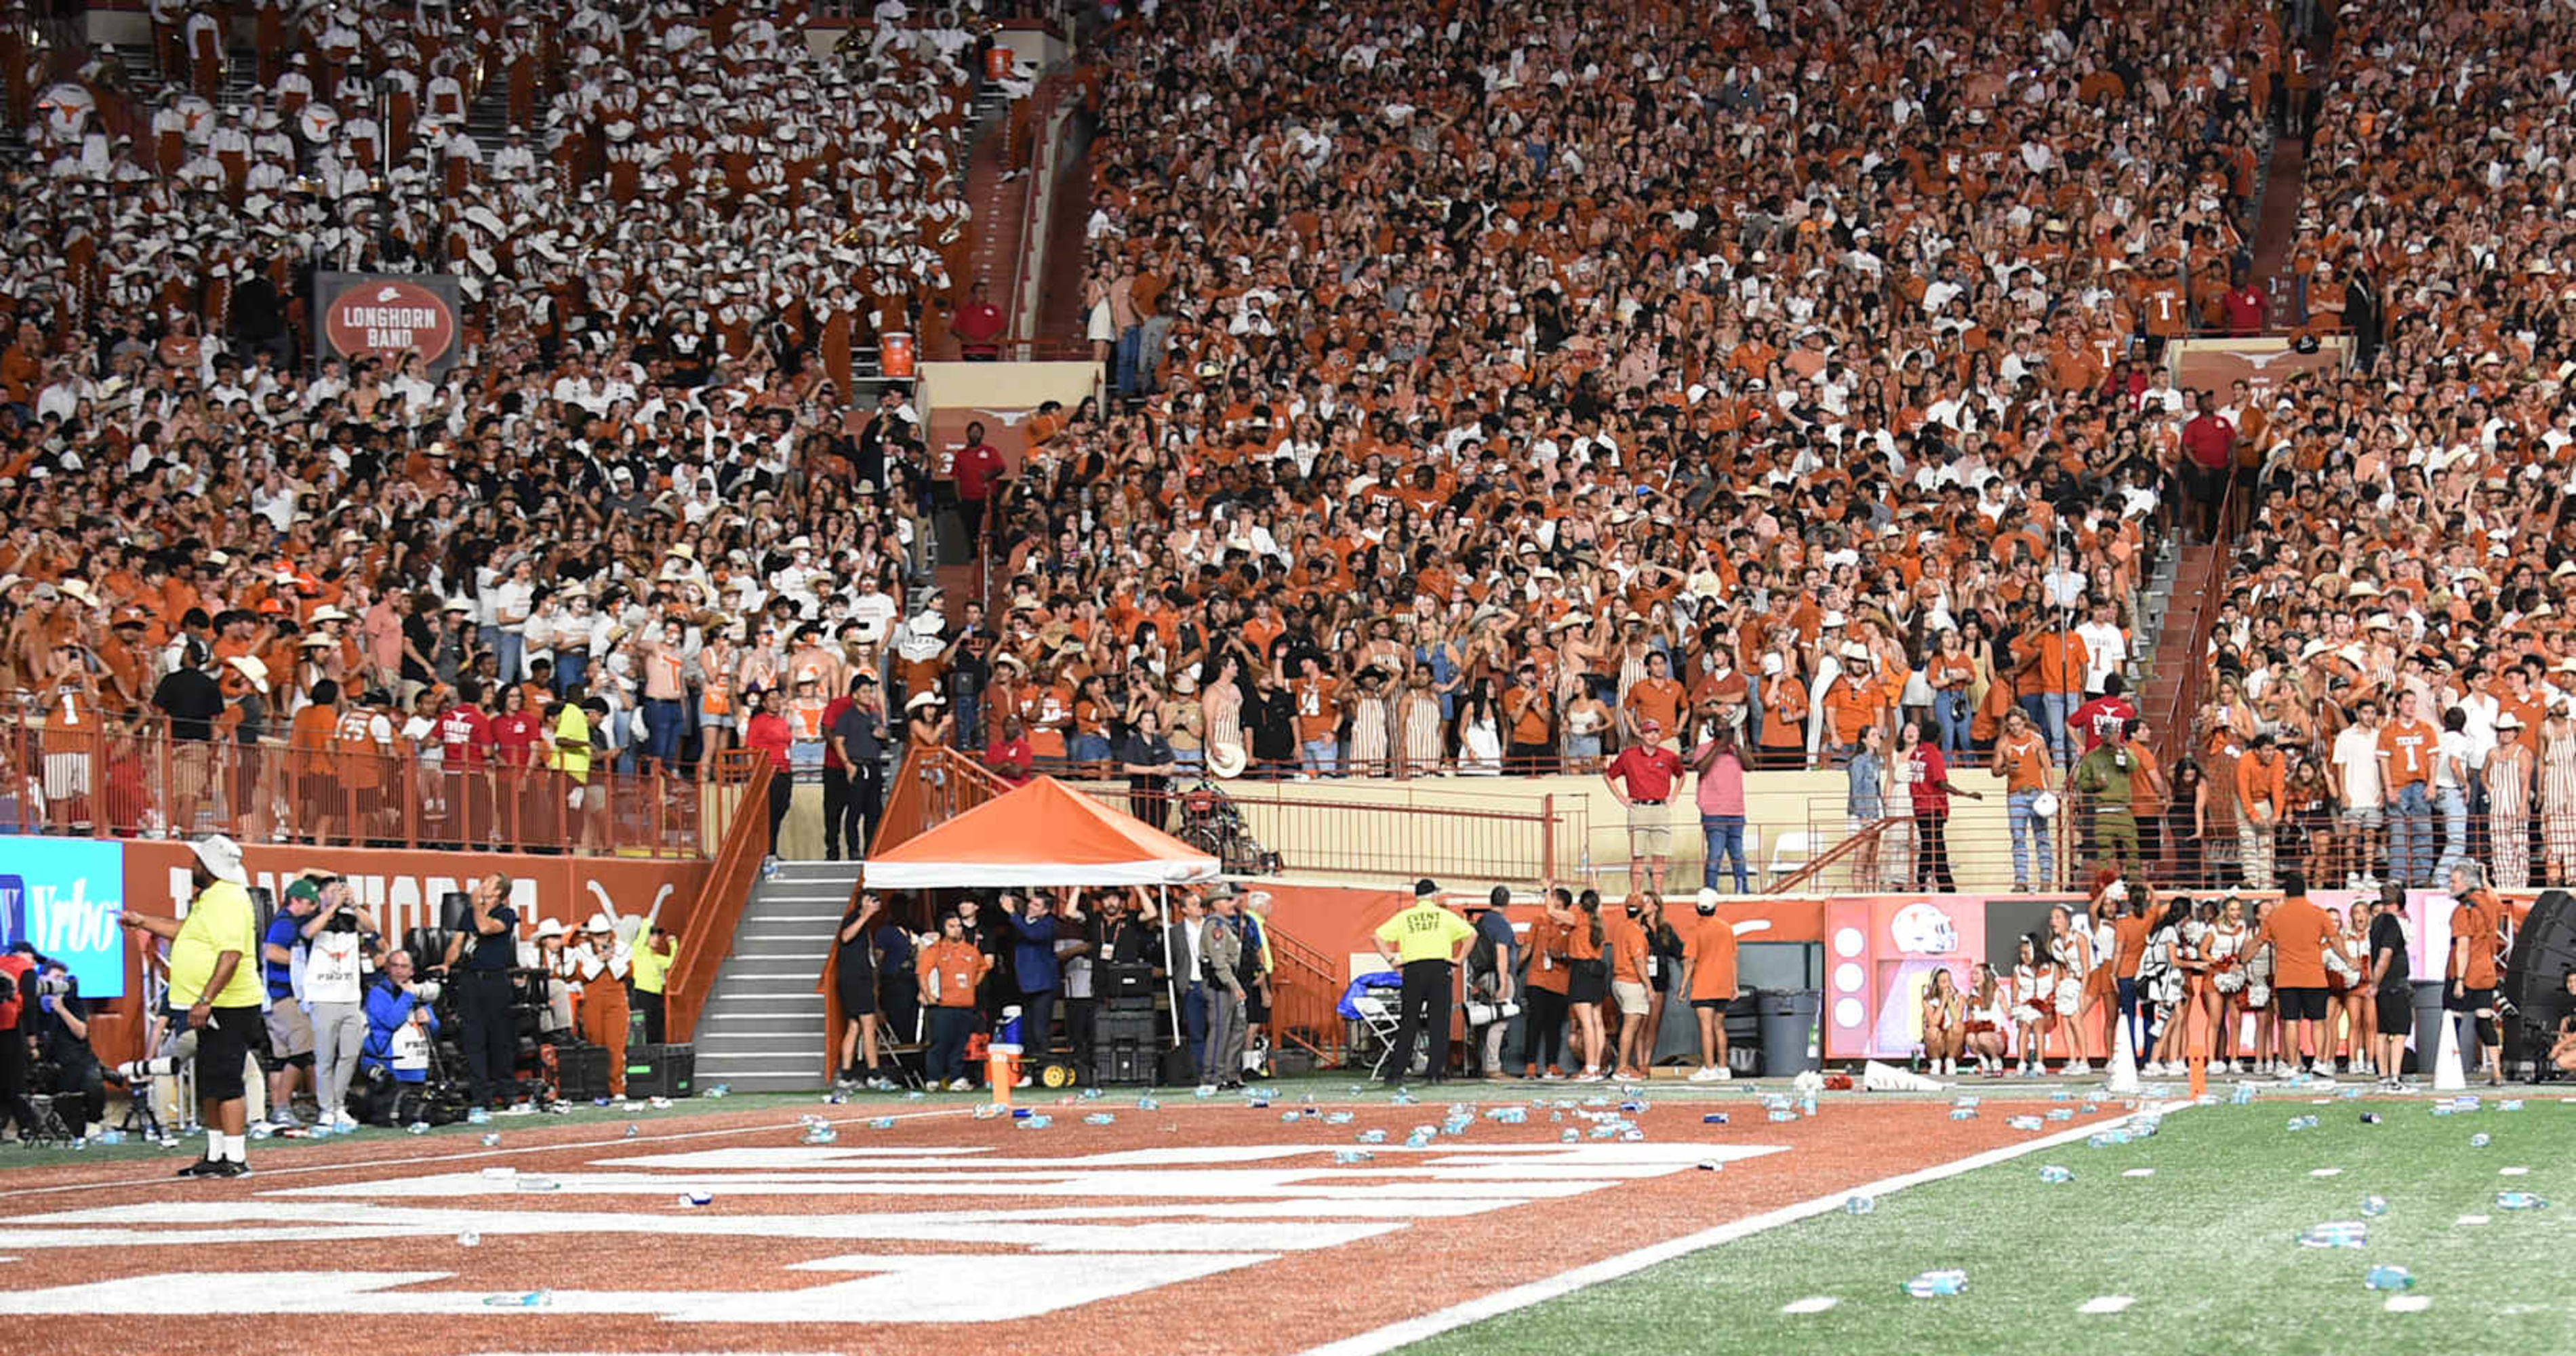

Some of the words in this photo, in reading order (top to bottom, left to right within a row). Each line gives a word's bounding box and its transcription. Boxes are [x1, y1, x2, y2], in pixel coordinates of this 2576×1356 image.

[343, 307, 436, 328] LONGHORN
[2160, 298, 2170, 319] 1
[367, 328, 413, 348] BAND
[2093, 647, 2101, 671] 1
[62, 693, 79, 725] 1
[2405, 745, 2419, 772] 1
[31, 878, 115, 953] Vrbo
[1407, 911, 1440, 924] EVENT
[1408, 921, 1438, 934] STAFF
